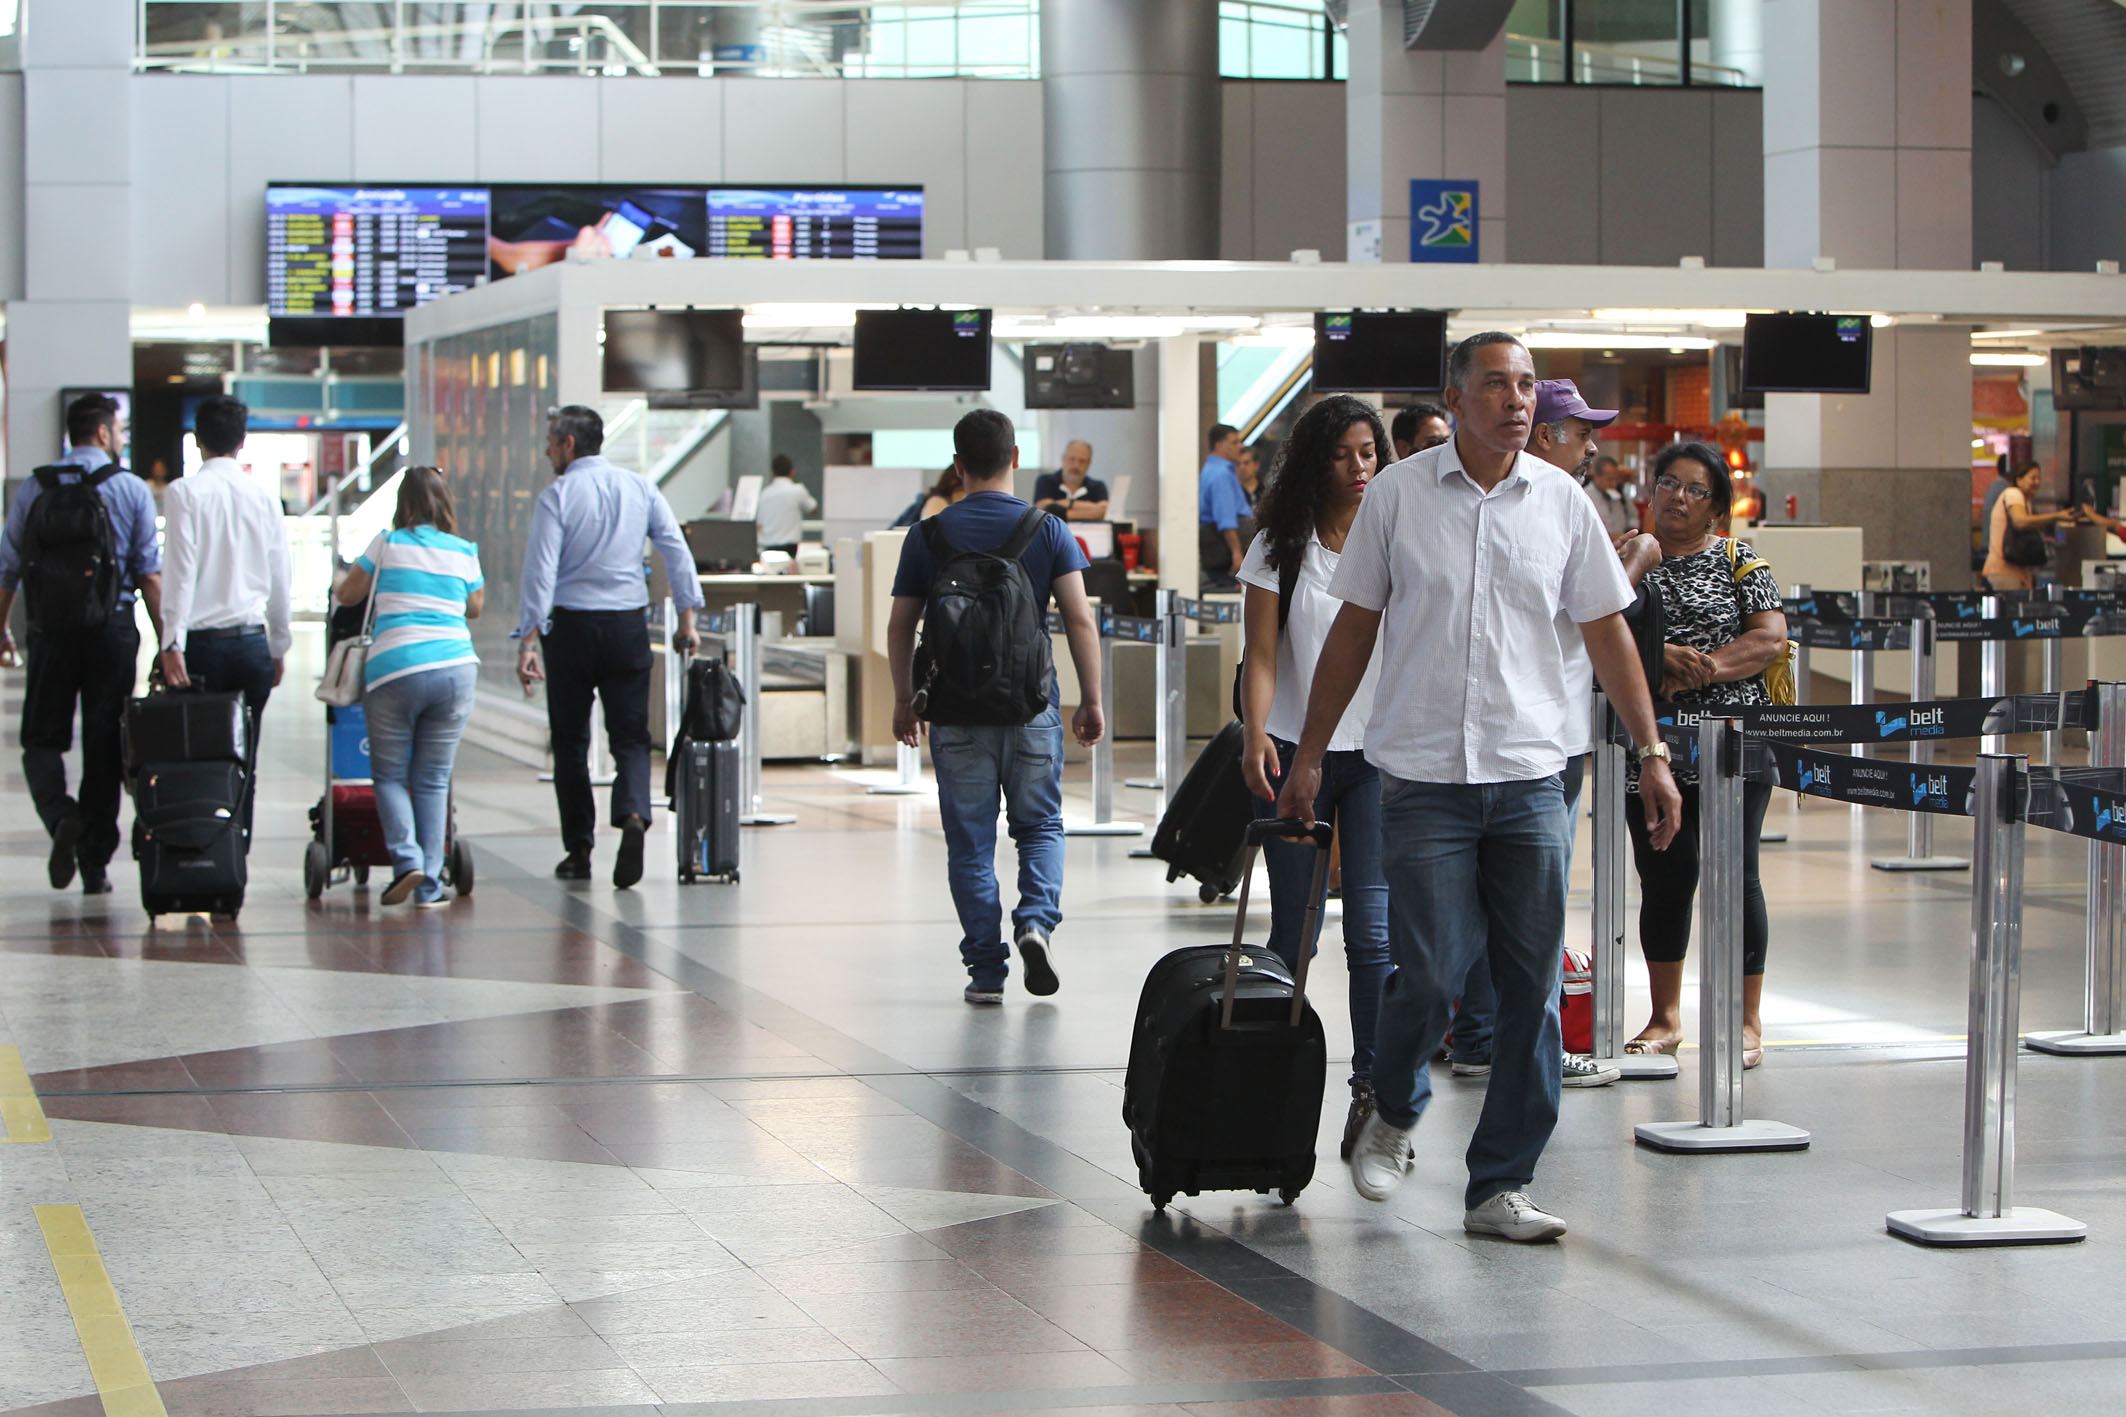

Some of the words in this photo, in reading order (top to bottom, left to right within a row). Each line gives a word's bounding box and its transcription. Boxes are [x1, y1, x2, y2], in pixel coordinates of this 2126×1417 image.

[2036, 617, 2058, 630] belt
[1759, 713, 1800, 722] ANUNCIE
[1910, 707, 1945, 726] belt
[1745, 728, 1844, 737] www.beltmedia.com.br
[1910, 725, 1946, 737] media
[1813, 762, 1832, 785] belt
[1928, 773, 1948, 795] belt
